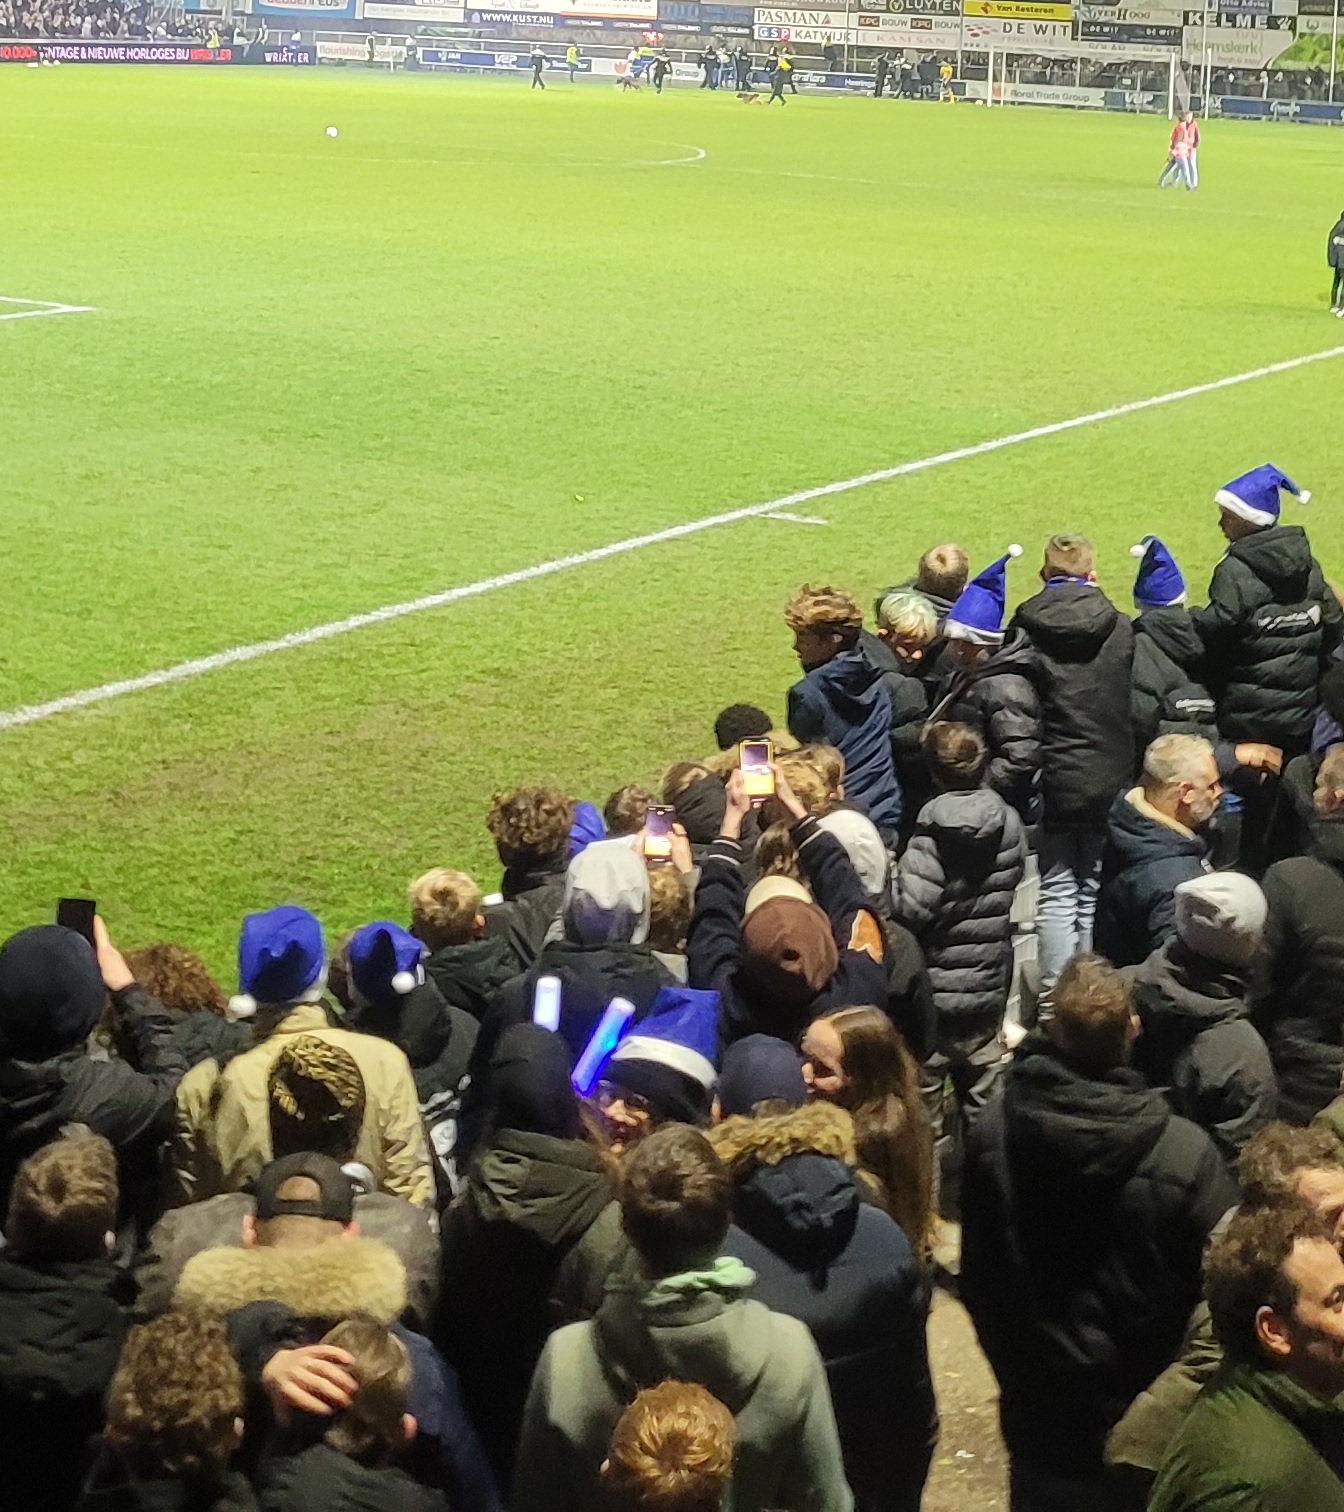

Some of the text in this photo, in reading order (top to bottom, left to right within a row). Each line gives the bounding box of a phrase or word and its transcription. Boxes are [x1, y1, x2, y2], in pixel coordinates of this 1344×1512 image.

[905, 0, 961, 11] LUYTEN
[756, 9, 821, 25] PASMAN
[881, 18, 908, 27] BOUW
[1188, 11, 1269, 29] KELME
[759, 27, 790, 39] GSP
[1002, 22, 1070, 37] DE WIT
[87, 47, 125, 60] NIEUWE
[126, 47, 176, 61] HORLOGES
